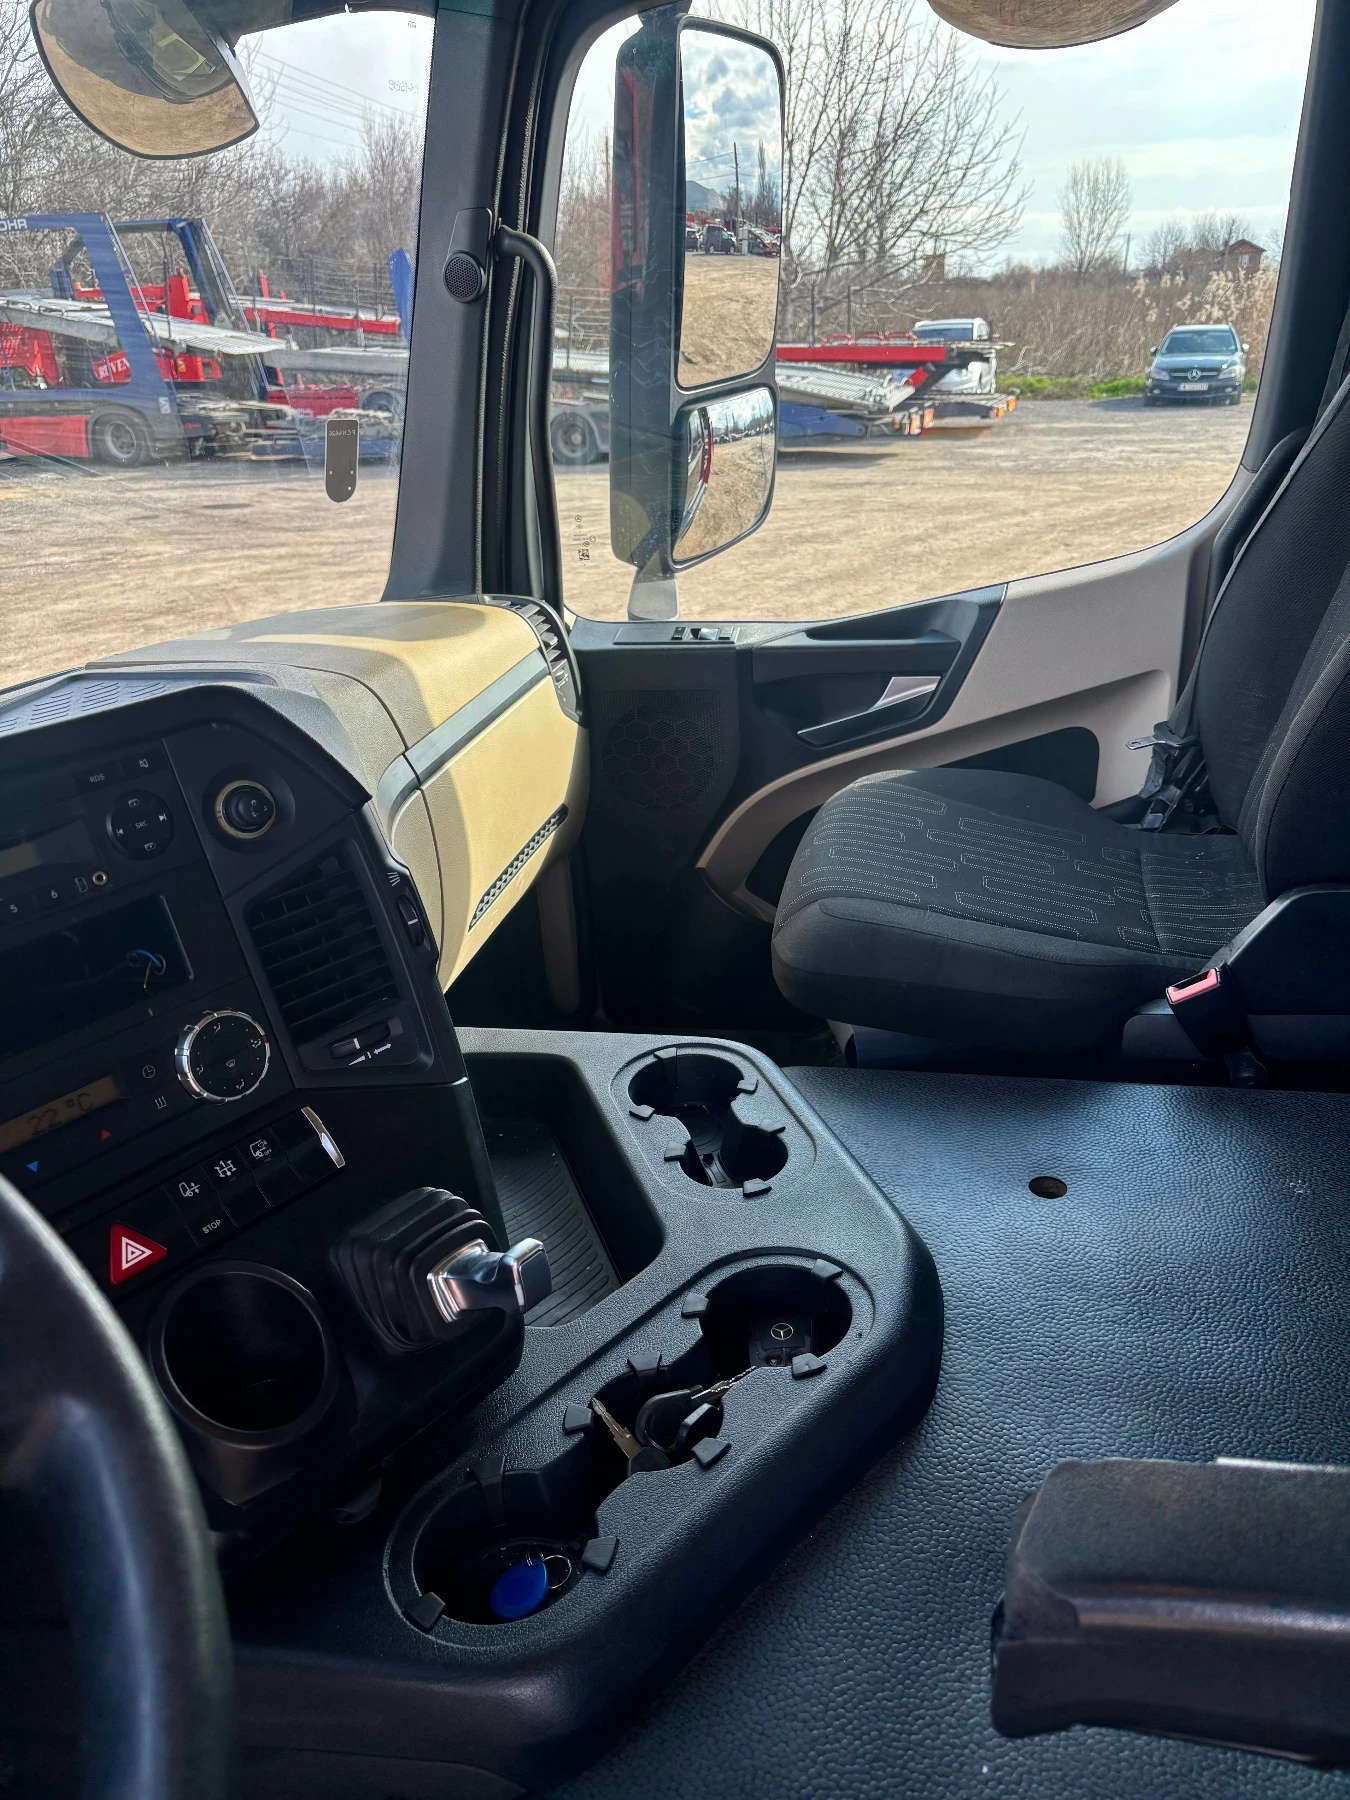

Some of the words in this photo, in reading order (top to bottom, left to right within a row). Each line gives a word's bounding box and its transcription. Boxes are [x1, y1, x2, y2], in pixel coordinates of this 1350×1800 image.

[89, 773, 105, 783] RDS
[135, 820, 148, 829] SRC
[51, 889, 58, 899] 6
[10, 904, 19, 913] 5
[202, 1219, 221, 1234] STOP
